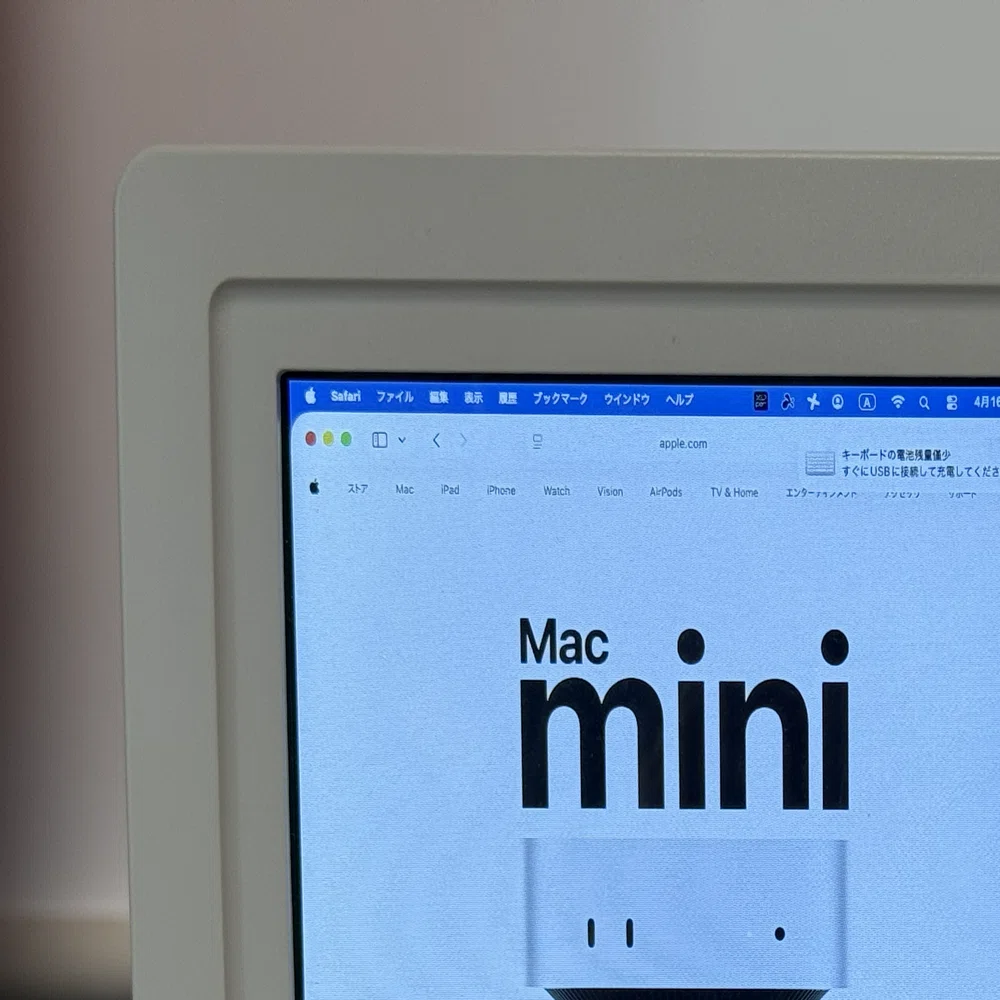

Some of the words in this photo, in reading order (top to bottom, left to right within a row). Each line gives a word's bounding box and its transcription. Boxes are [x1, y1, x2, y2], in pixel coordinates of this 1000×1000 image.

[331, 390, 361, 402] Safari
[377, 391, 414, 403] ファイル
[464, 391, 483, 404] 表示
[533, 392, 588, 405] ブックマーク
[604, 393, 650, 406] ウインドウ
[665, 393, 694, 406] ヘルプ
[659, 438, 708, 450] apple.com
[842, 449, 951, 461] キーボードの電池残量僅少
[348, 483, 369, 494] ストア
[395, 484, 415, 495] Mac
[441, 484, 460, 495] iPad
[487, 485, 516, 496] iPhone
[544, 486, 570, 497] Watch
[597, 486, 624, 497] Vision
[650, 486, 683, 497] AirPods
[711, 487, 722, 497] TV
[724, 487, 731, 497] &
[733, 487, 759, 498] Home
[519, 617, 609, 664] Mac
[519, 628, 850, 810] mini
